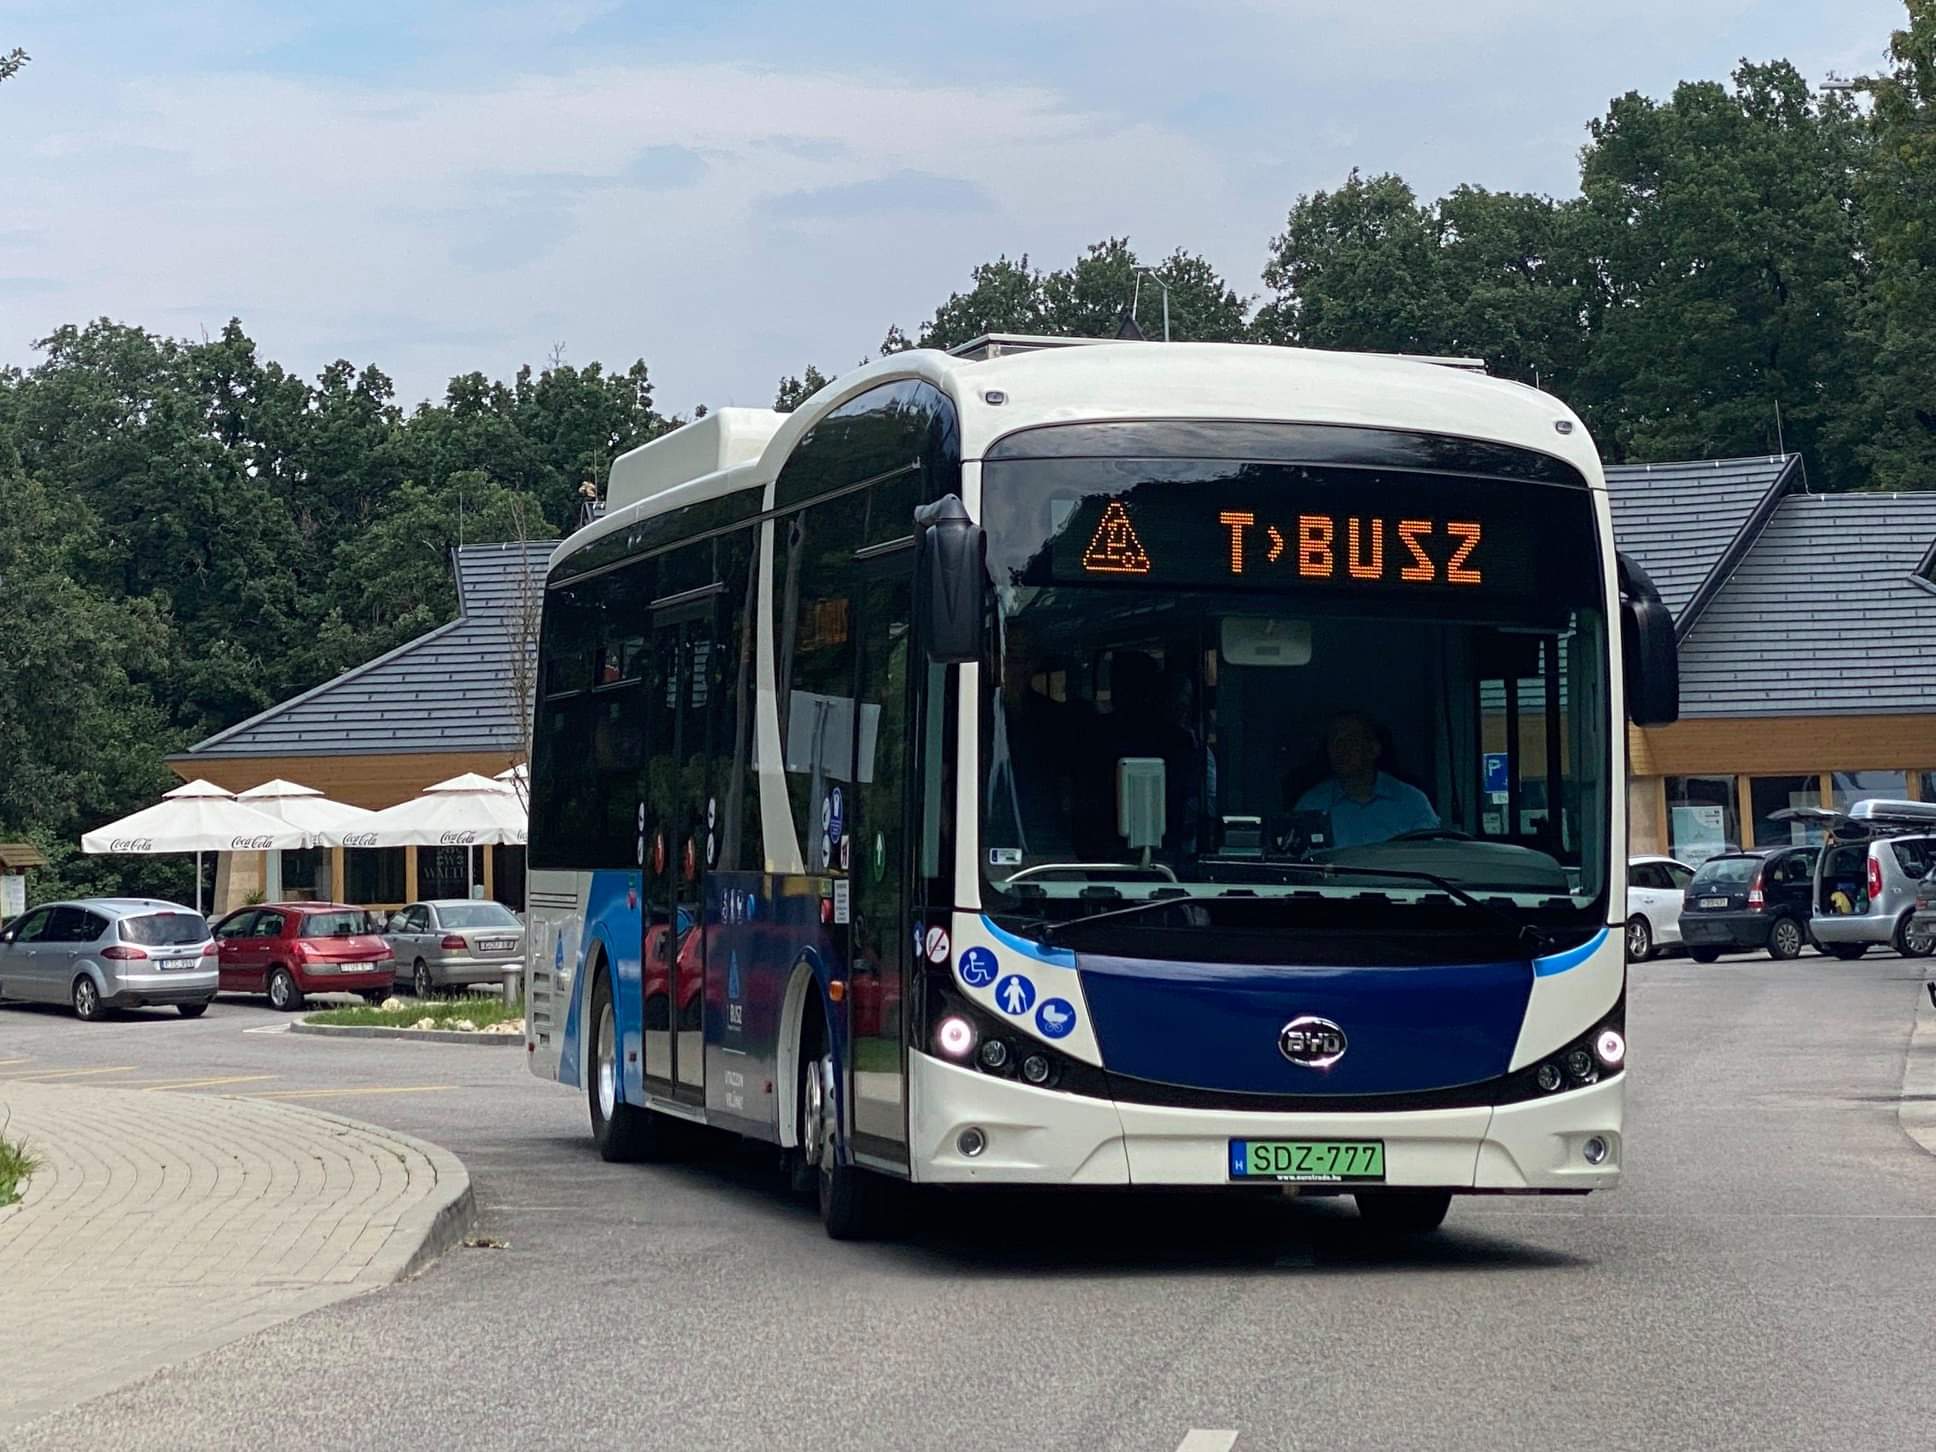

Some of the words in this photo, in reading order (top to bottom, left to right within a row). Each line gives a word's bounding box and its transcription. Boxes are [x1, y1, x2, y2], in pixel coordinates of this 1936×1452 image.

[1288, 1031, 1340, 1053] BYD
[1235, 1160, 1244, 1171] H
[1254, 1145, 1377, 1173] SDZ-777
